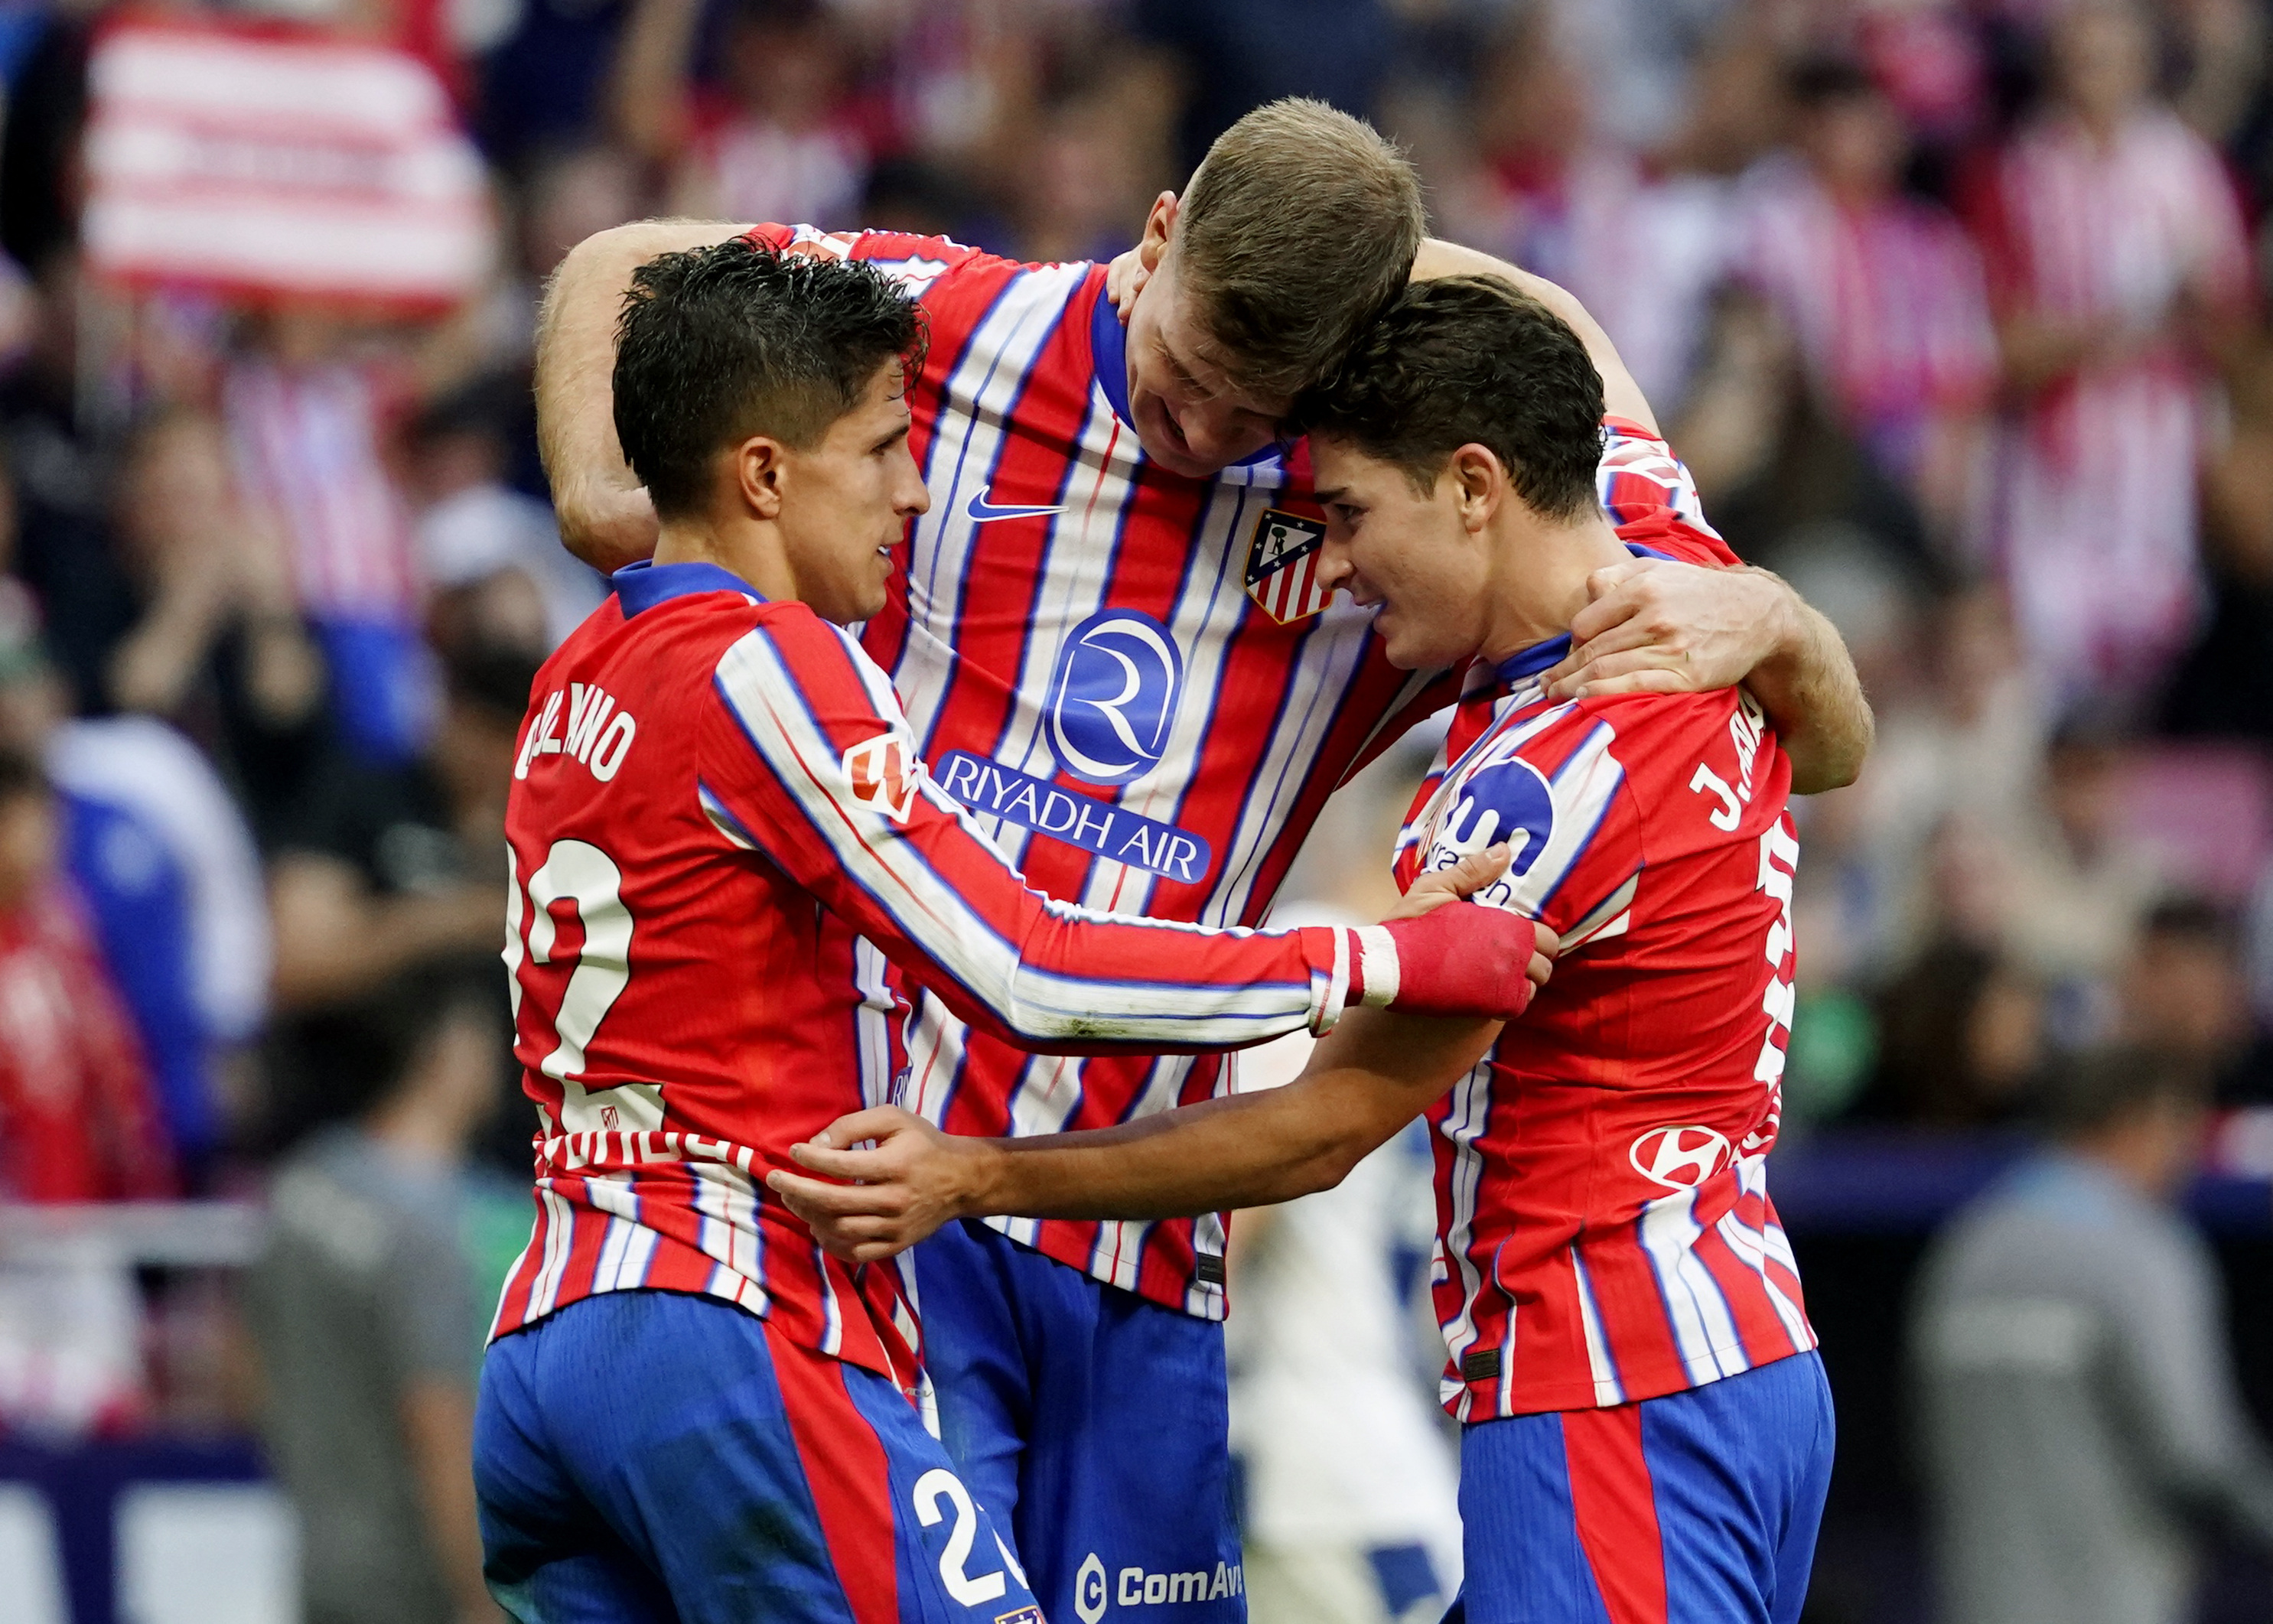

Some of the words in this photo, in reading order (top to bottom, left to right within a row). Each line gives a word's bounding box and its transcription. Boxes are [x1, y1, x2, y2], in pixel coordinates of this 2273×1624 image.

[942, 754, 1115, 849] RIYADH
[1118, 825, 1197, 880] AIR
[501, 838, 666, 1140] 2
[913, 1468, 1030, 1607] 2
